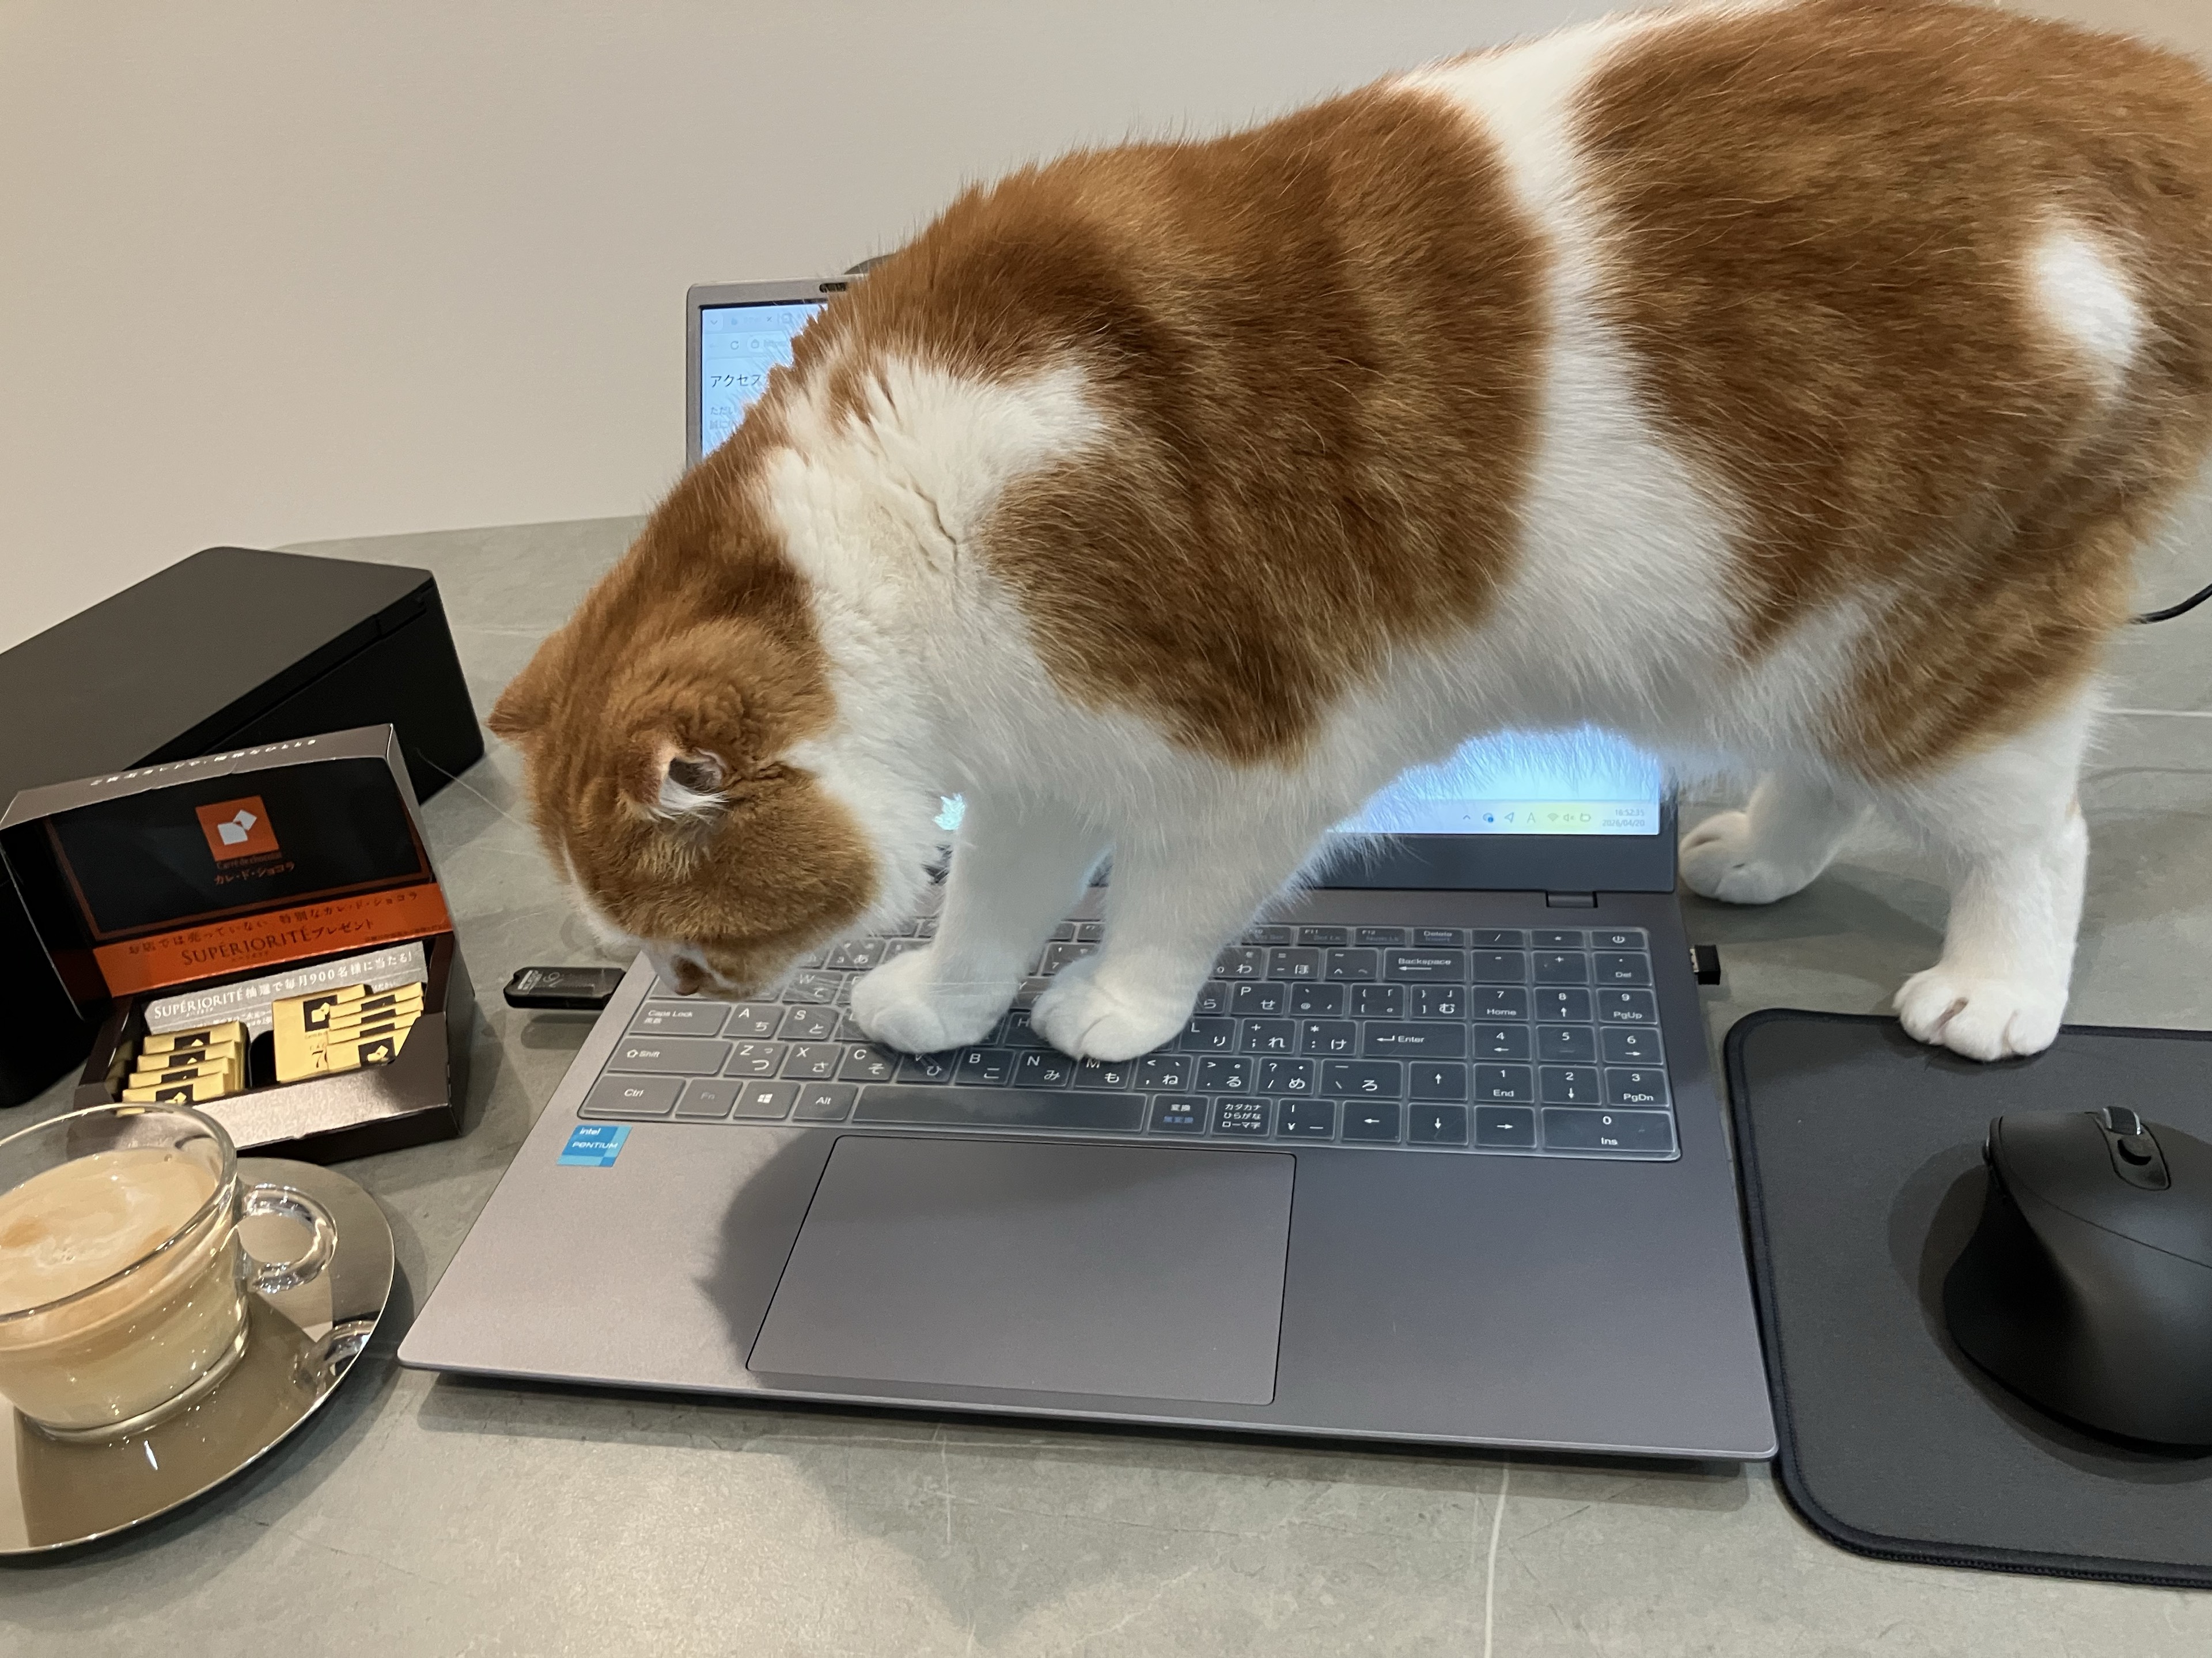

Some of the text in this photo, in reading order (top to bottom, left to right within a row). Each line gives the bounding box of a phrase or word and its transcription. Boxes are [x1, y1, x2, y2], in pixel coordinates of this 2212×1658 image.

[1398, 957, 1452, 966] Backspace
[1240, 986, 1252, 996] P
[1497, 990, 1504, 998] 7
[1558, 993, 1567, 1001] 8
[1621, 993, 1630, 1001] 9
[1260, 1000, 1275, 1010] せ
[738, 1008, 749, 1018] A
[794, 1009, 806, 1020] S
[1613, 1011, 1643, 1020] PgUp
[1496, 1032, 1505, 1040] 4
[1562, 1032, 1570, 1041] 5
[1627, 1035, 1637, 1044] 6
[1213, 1036, 1226, 1047] り
[1268, 1037, 1285, 1048] れ
[1331, 1039, 1347, 1050] け
[740, 1044, 754, 1055] Z
[796, 1047, 810, 1058] X
[853, 1049, 867, 1060] C
[312, 1048, 328, 1069] 7
[968, 1053, 981, 1064] B
[1027, 1055, 1040, 1066] N
[1044, 1070, 1060, 1081] み
[1104, 1072, 1120, 1083] も
[1501, 1069, 1506, 1078] 1
[1565, 1072, 1574, 1081] 2
[1631, 1073, 1641, 1082] 3
[1162, 1074, 1179, 1085] ね
[1226, 1076, 1241, 1088] る
[1289, 1078, 1305, 1089] め
[1362, 1080, 1378, 1092] ろ
[624, 1088, 644, 1097] Ctrl
[1493, 1089, 1514, 1097] End
[815, 1096, 831, 1105] Alt
[1623, 1093, 1654, 1103] PgDn
[1224, 1112, 1261, 1120] ひらがな
[1603, 1116, 1612, 1125] 0
[1222, 1121, 1261, 1129] ローマ字
[579, 1127, 601, 1135] intel
[1601, 1137, 1618, 1145] Ins
